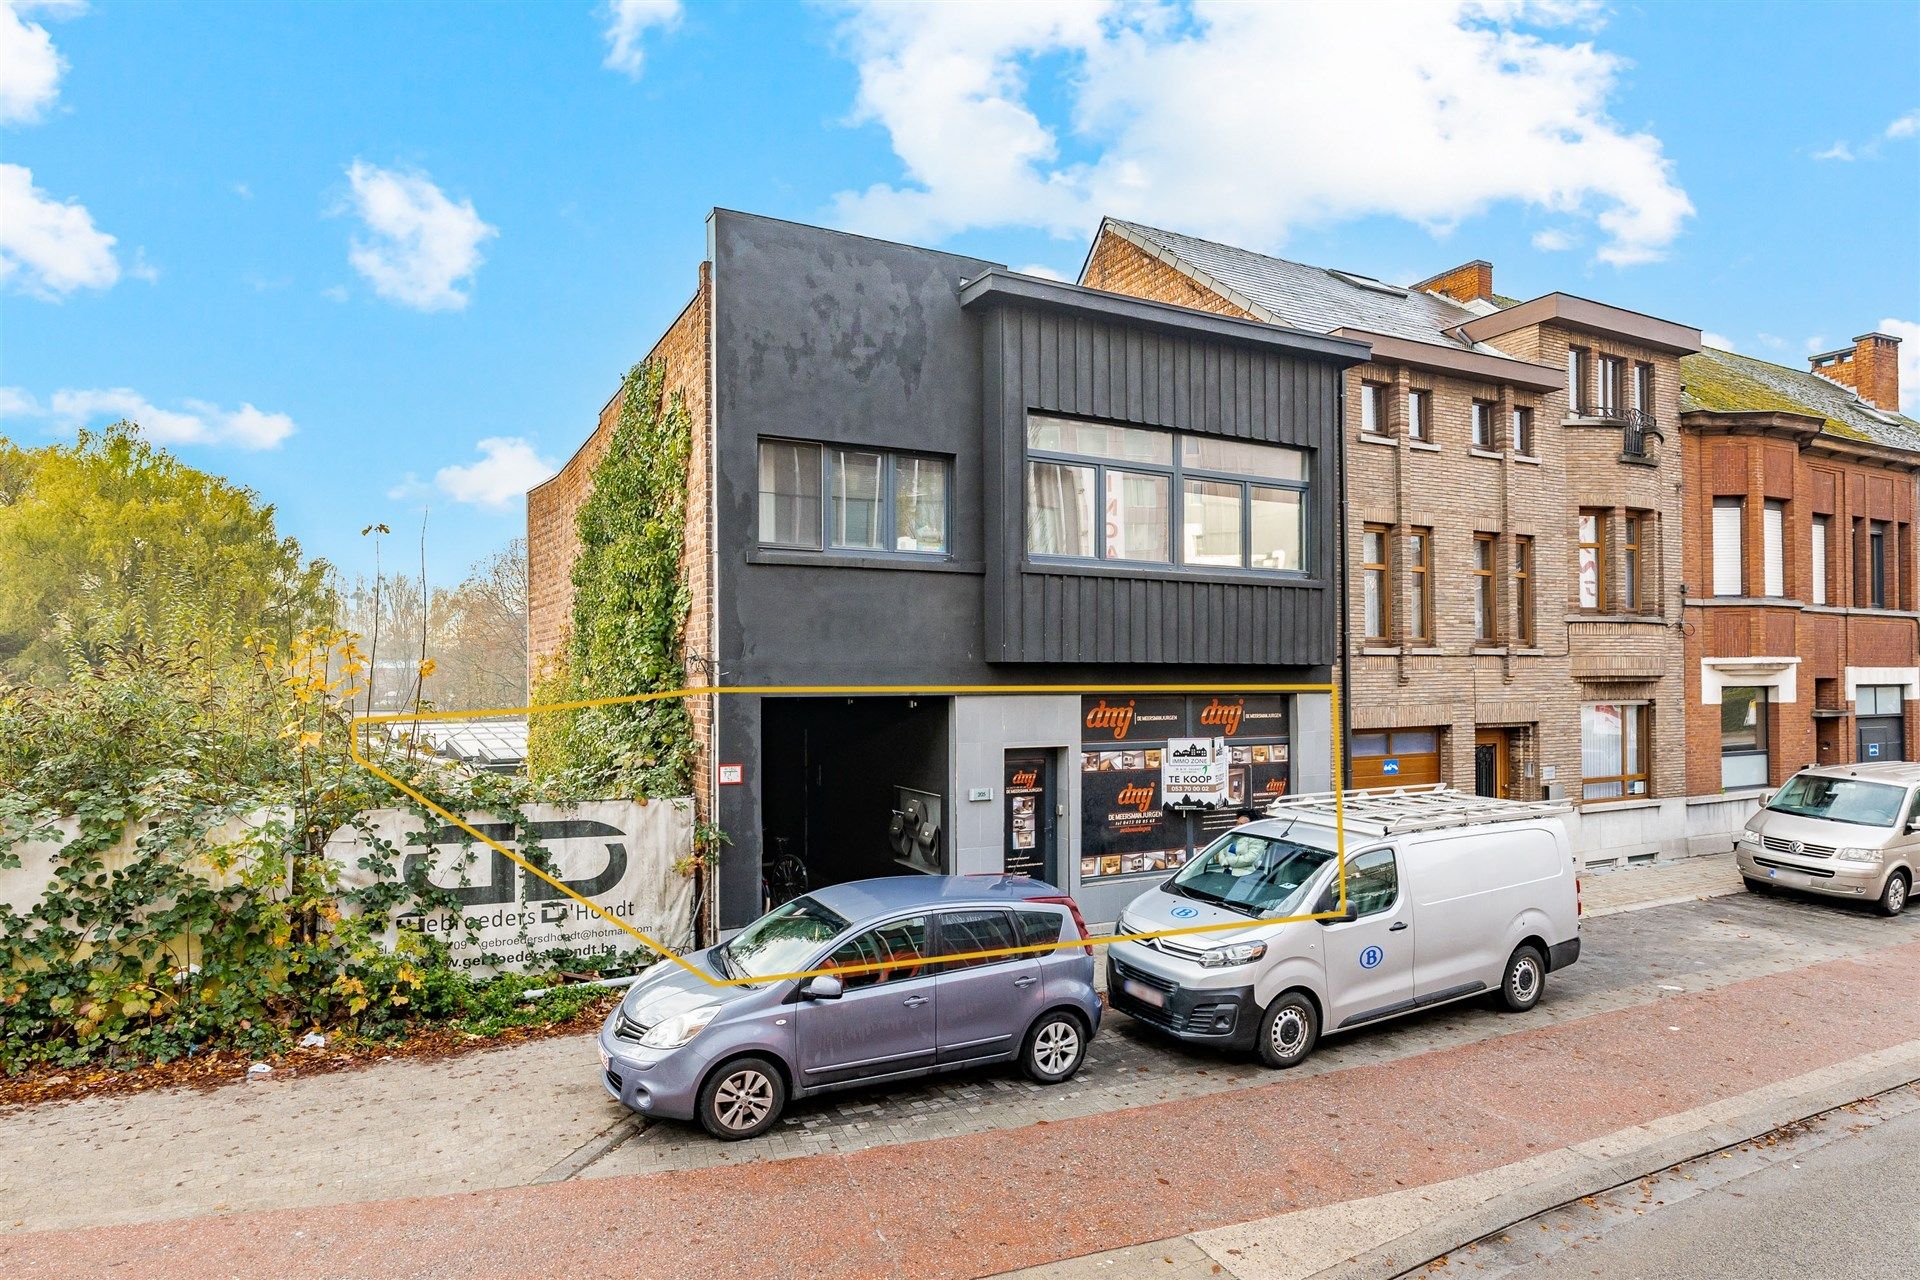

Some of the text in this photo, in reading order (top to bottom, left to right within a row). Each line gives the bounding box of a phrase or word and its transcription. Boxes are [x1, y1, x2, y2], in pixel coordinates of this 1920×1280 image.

[1169, 775, 1180, 783] TE
[1183, 775, 1212, 783] KOOP
[1108, 813, 1115, 821] DE
